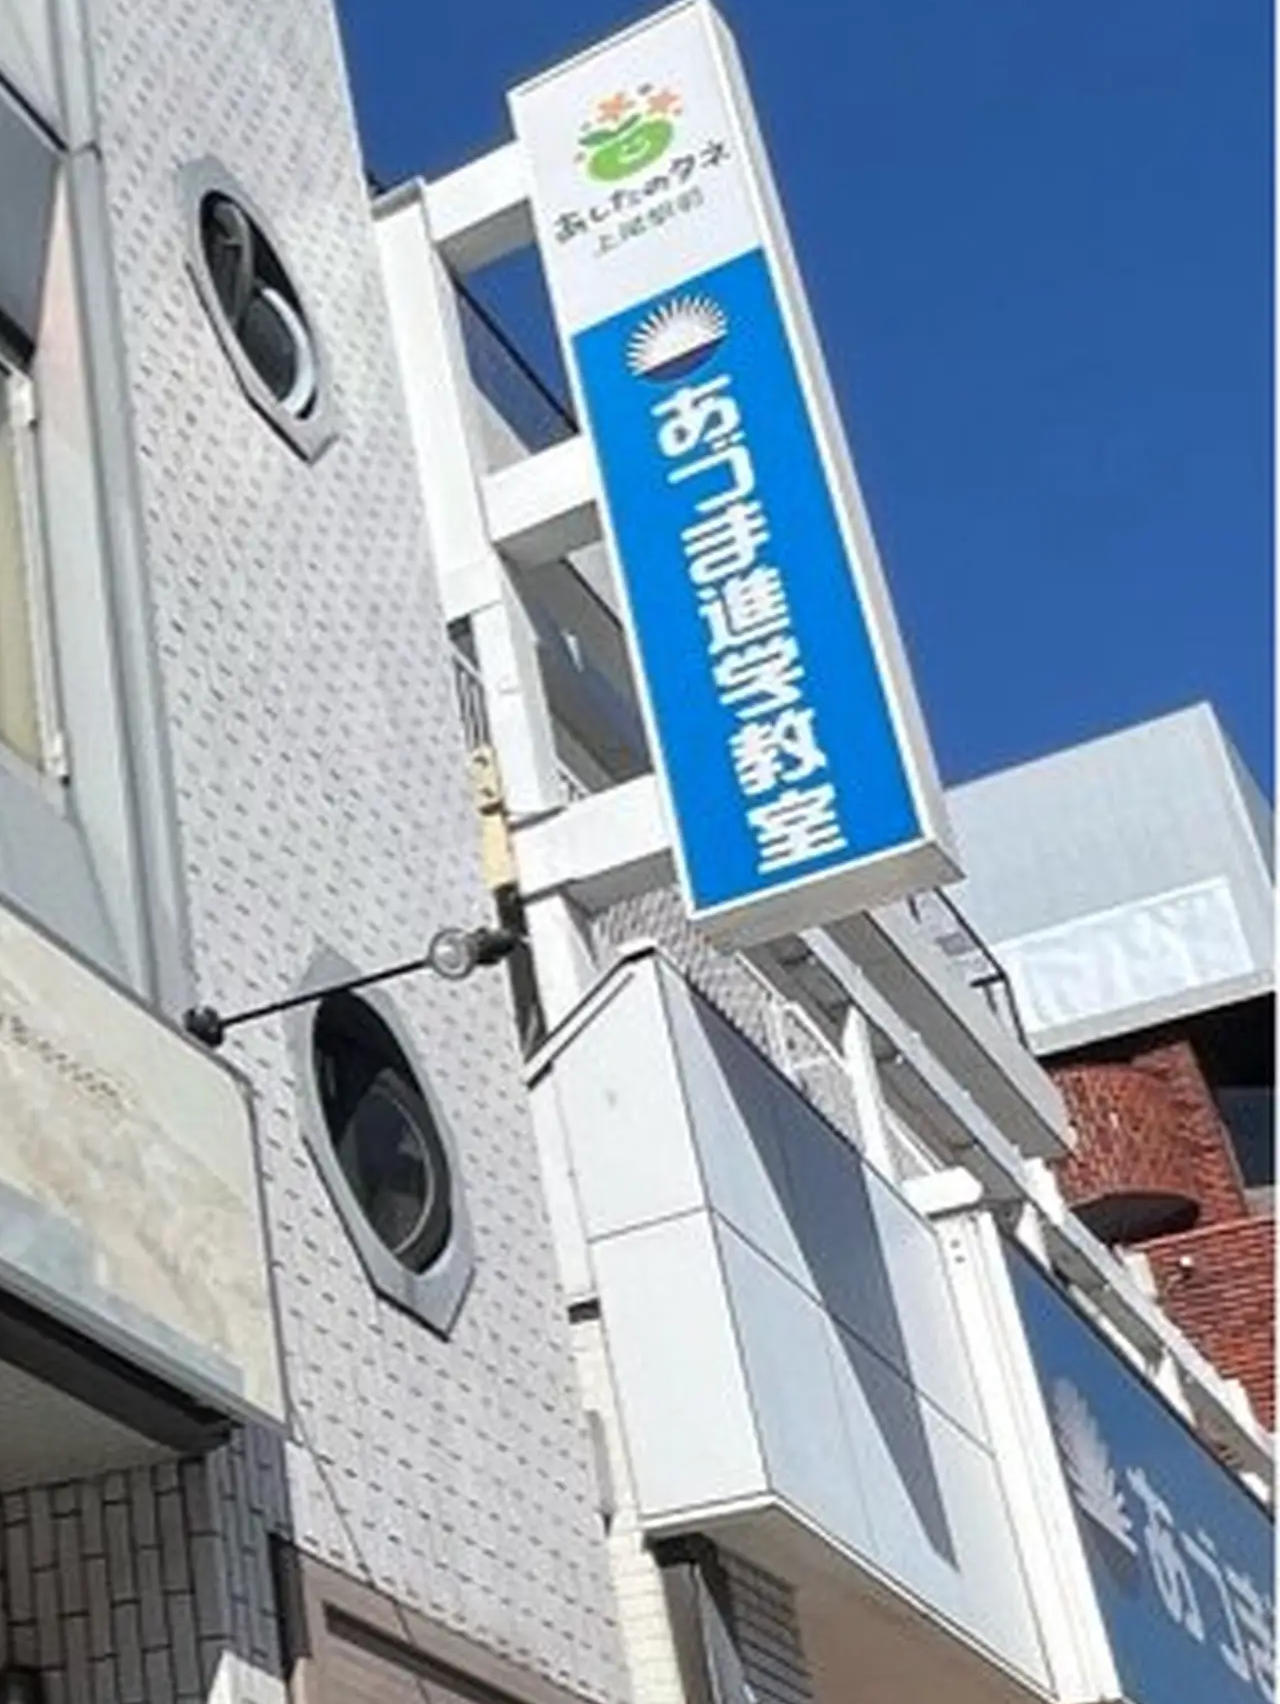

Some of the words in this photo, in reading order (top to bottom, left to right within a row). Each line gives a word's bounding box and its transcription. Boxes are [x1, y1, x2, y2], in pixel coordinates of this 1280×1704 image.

[649, 371, 848, 877] あづま進学教室
